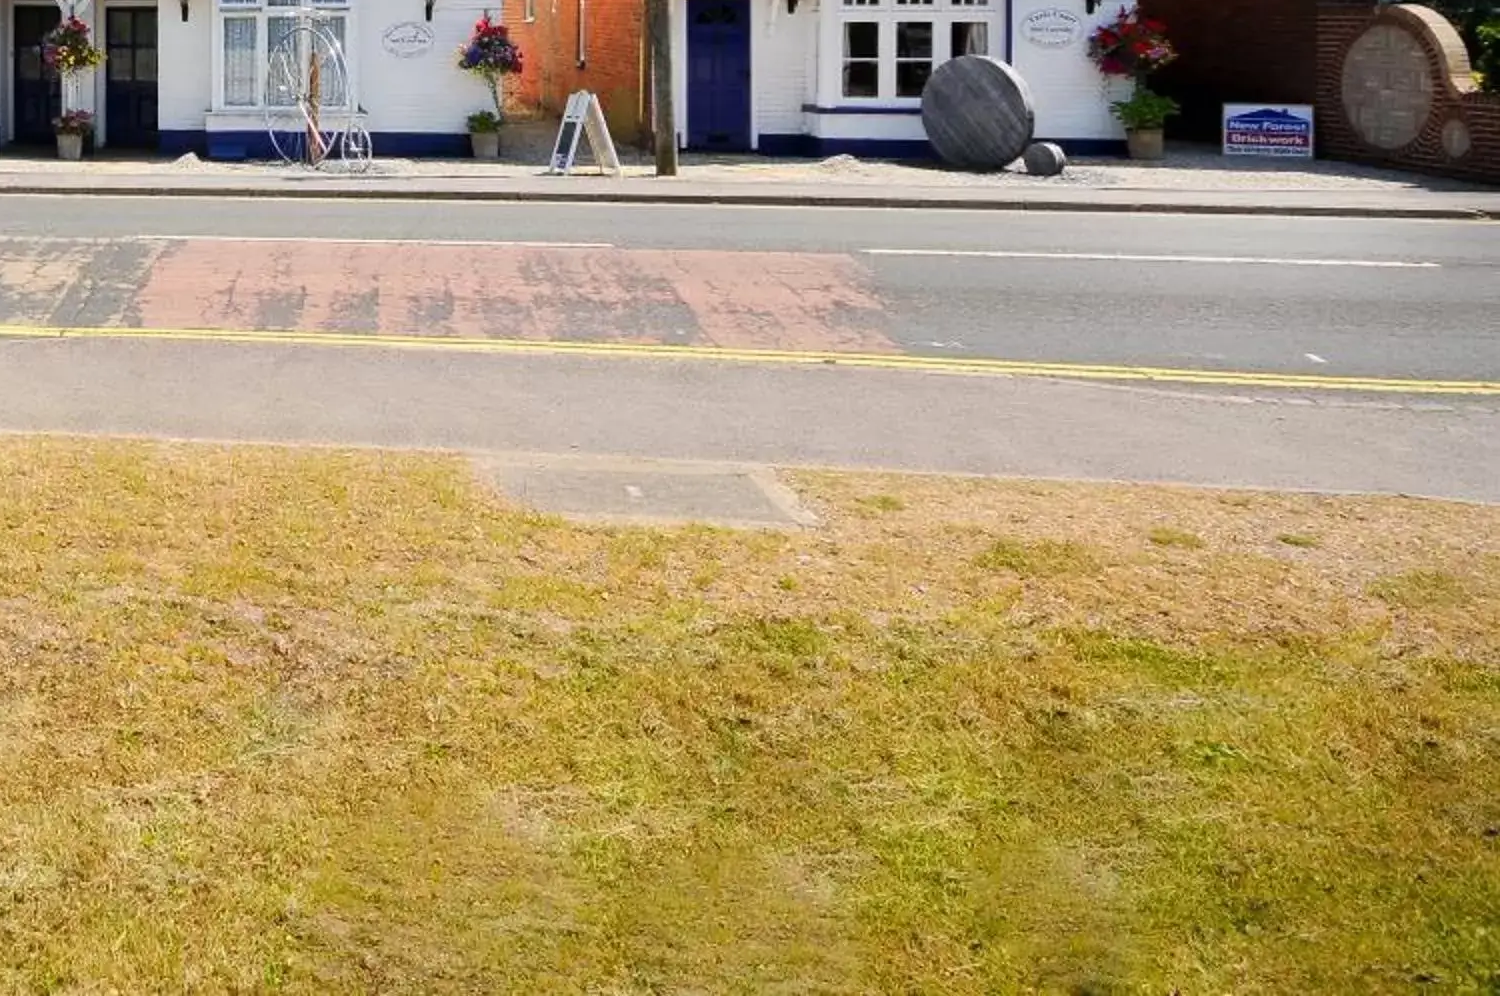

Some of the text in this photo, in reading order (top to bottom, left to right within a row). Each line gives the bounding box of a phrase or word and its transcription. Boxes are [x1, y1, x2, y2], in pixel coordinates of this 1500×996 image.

[1229, 120, 1307, 132] New Forest
[1231, 133, 1305, 146] Brickwork
